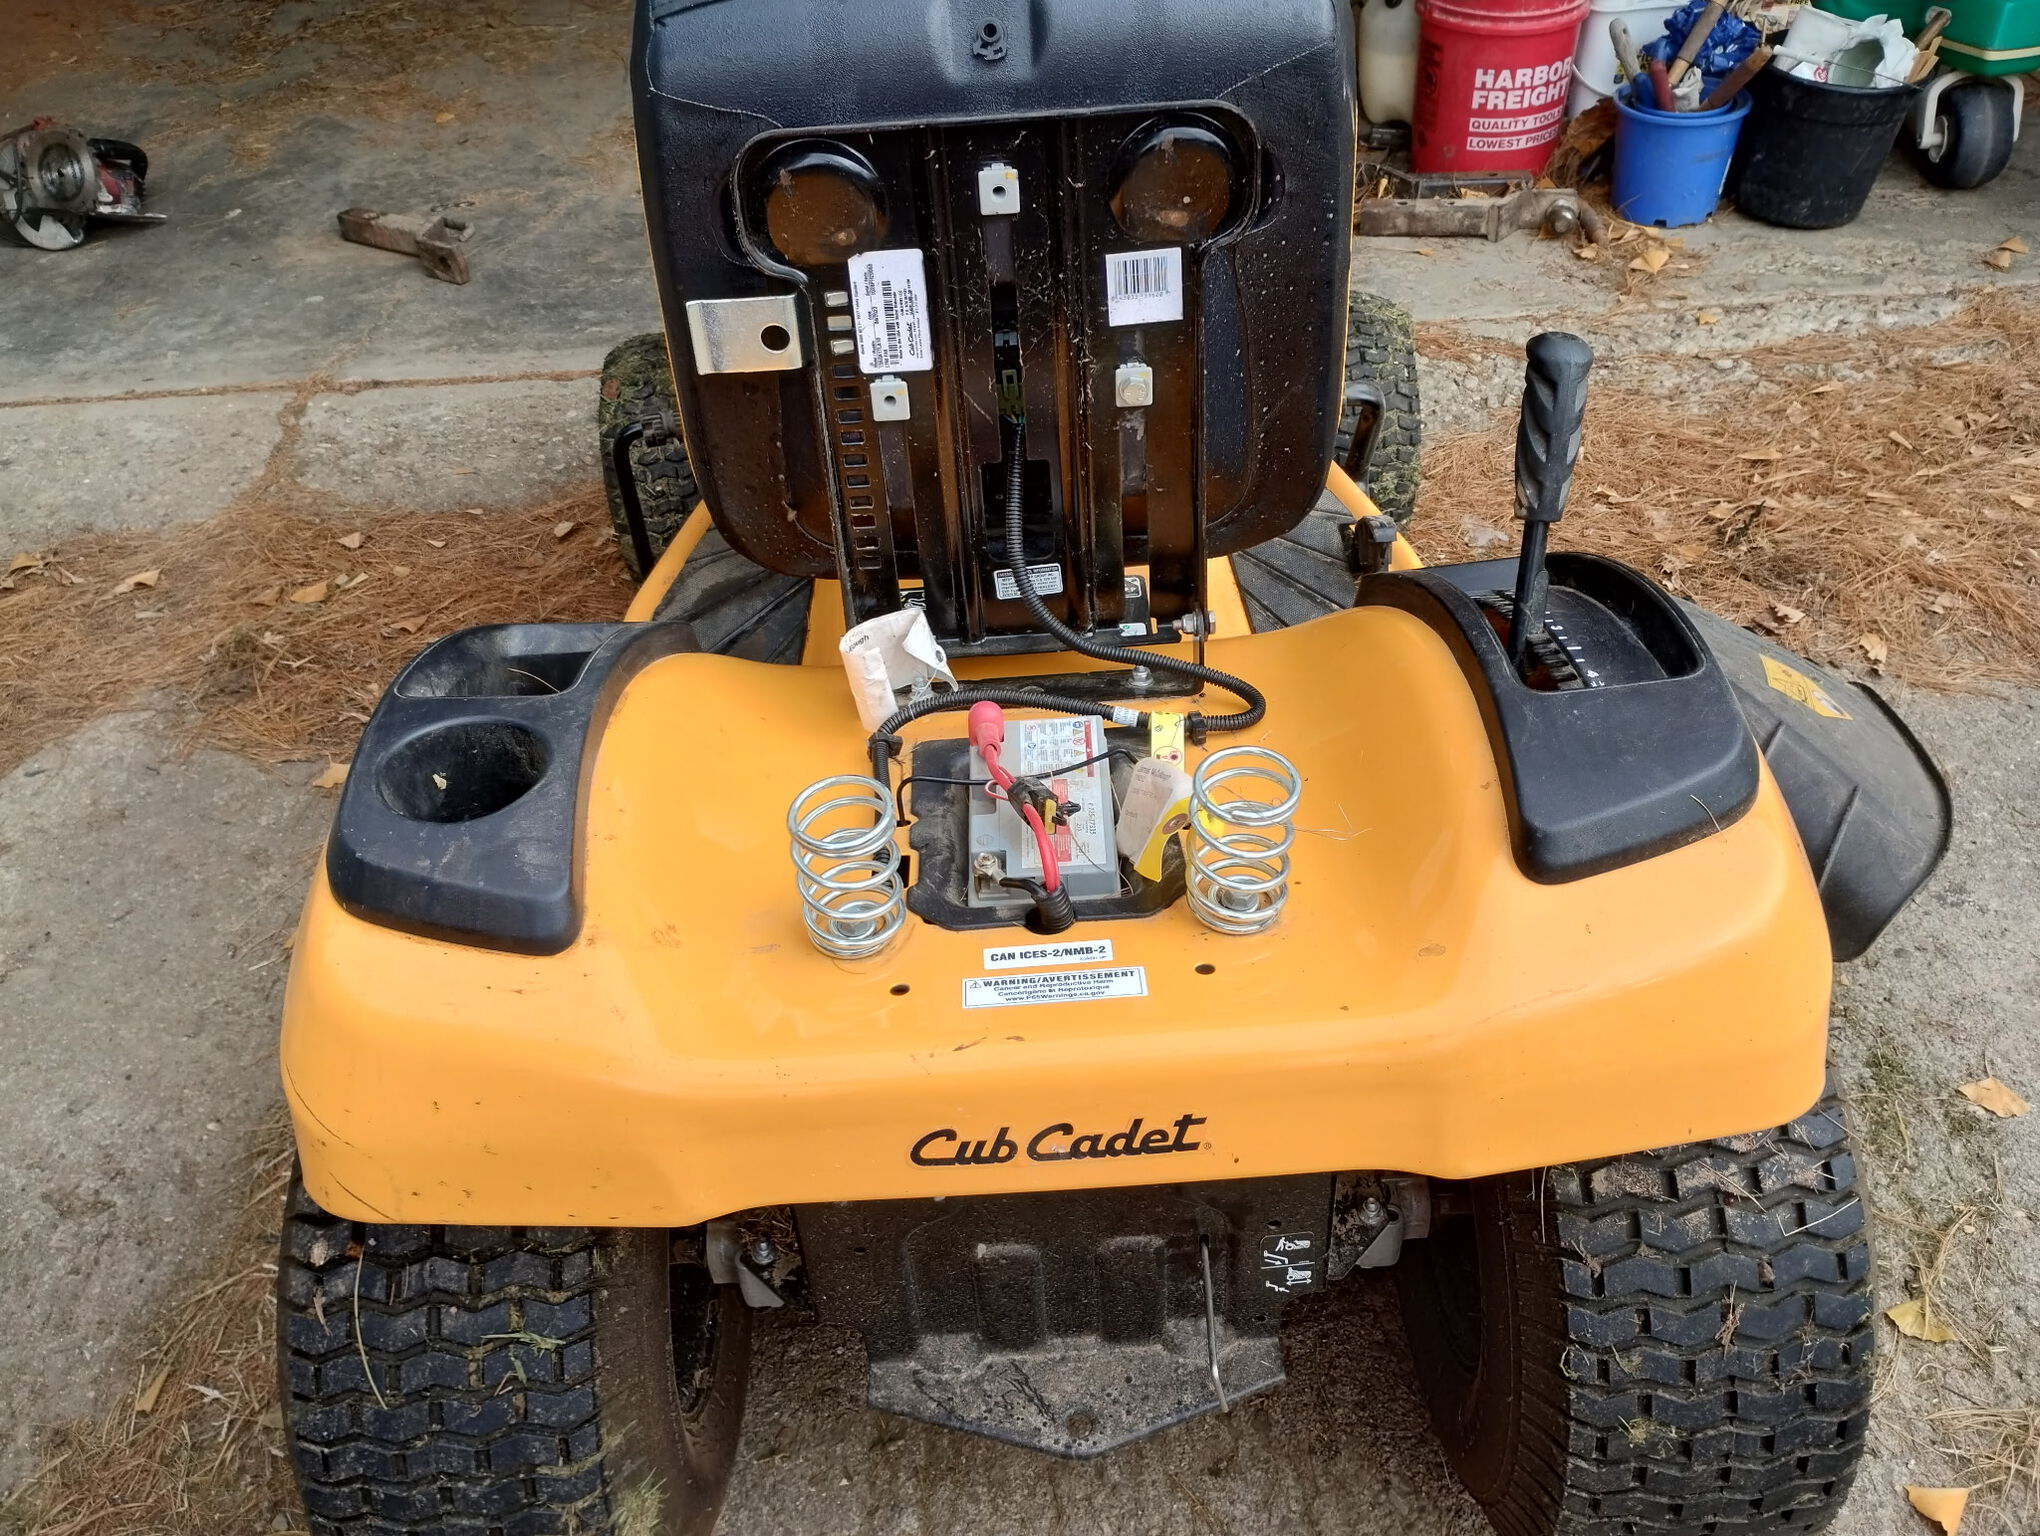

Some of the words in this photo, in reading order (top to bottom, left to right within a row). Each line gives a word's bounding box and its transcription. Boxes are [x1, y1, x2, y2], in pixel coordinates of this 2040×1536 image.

[1474, 56, 1573, 89] HARBOR
[1471, 78, 1571, 110] FREIGHT
[1471, 118, 1529, 130] QUALITY
[1533, 107, 1563, 126] TOOLS
[1469, 137, 1523, 149] LOWEST
[1525, 127, 1560, 145] PRICES
[990, 952, 1016, 962] CAN
[1019, 945, 1106, 960] ICES-2/NMB-2
[983, 970, 1135, 987] WARNING/AVERTISSEMENT
[1039, 980, 1092, 988] Reproductive
[910, 1126, 1018, 1166] Cub
[1026, 1113, 1207, 1161] Cadet
